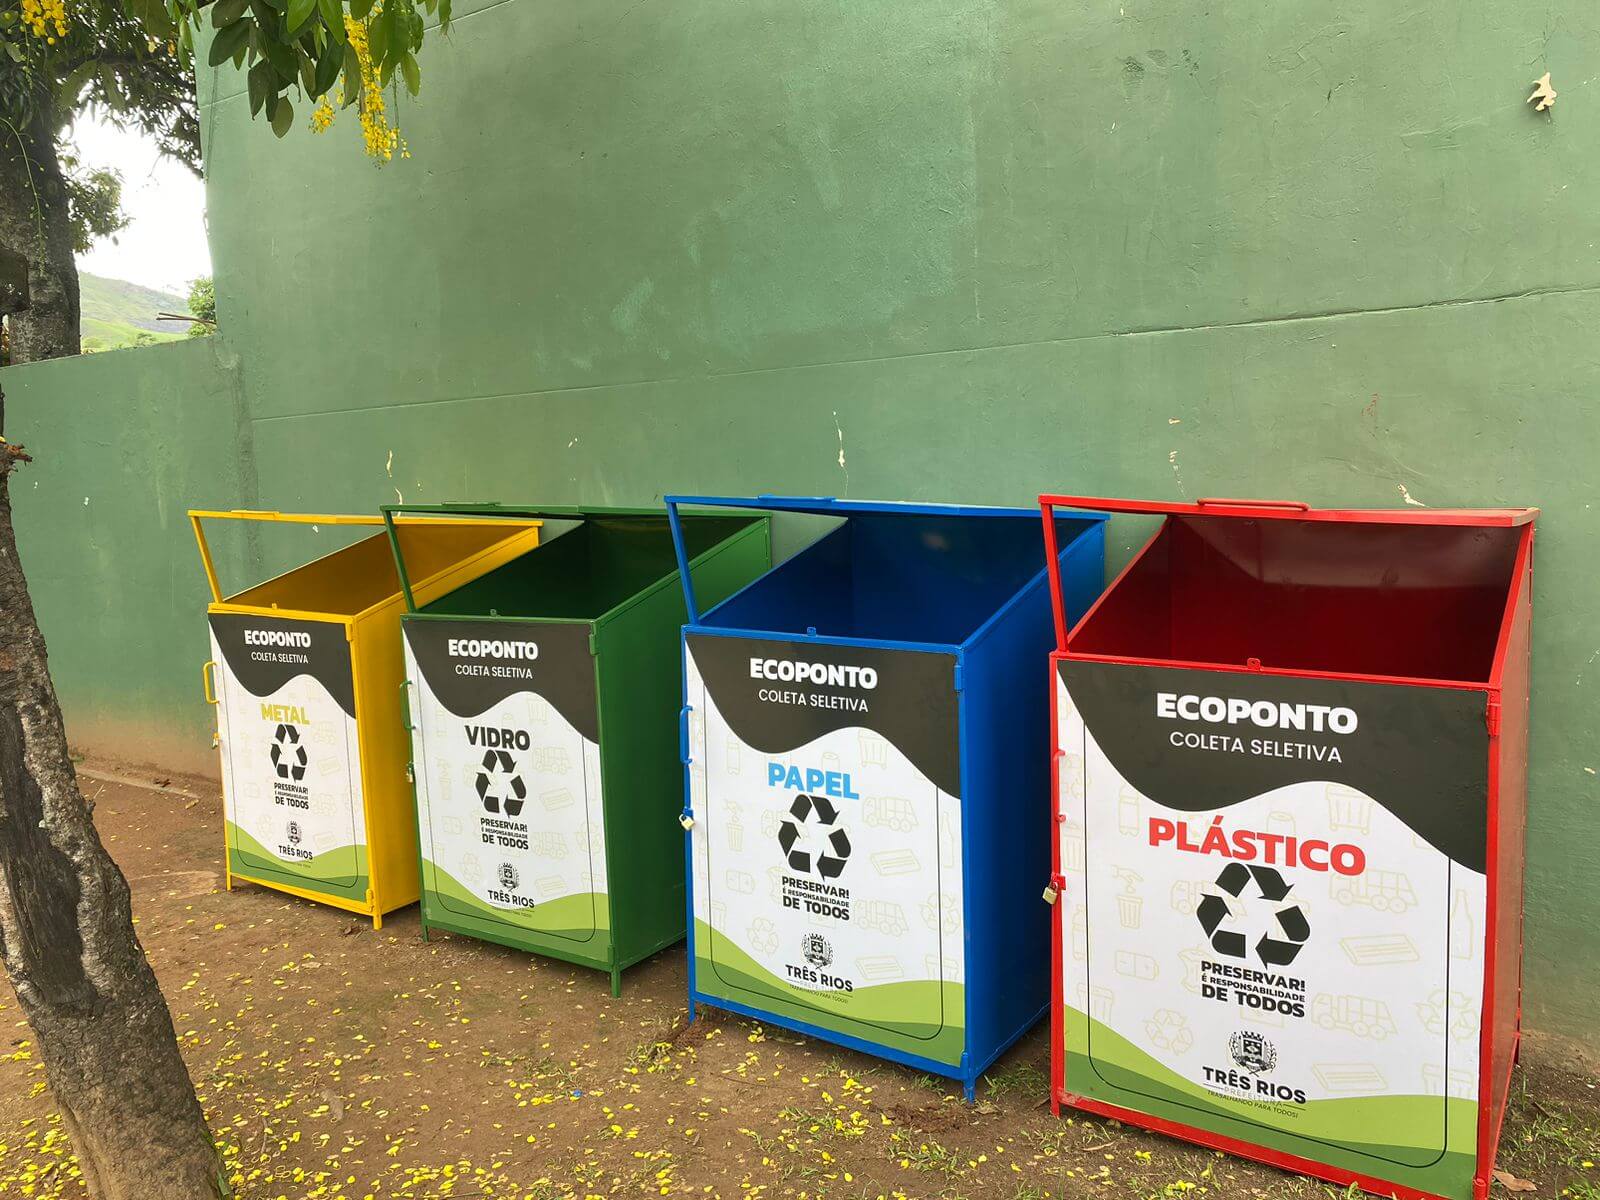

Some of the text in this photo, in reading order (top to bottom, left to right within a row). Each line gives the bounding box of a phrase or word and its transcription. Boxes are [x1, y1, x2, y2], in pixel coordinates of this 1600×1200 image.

[244, 630, 311, 648] ECOPONTO
[448, 639, 538, 660] ECOPONTO
[251, 652, 308, 664] COLETA SELETIVA
[455, 664, 532, 679] COLETA SELETIVA
[750, 658, 878, 689] ECOPONTO
[758, 689, 868, 712] COLETA SELETIVA
[262, 704, 310, 724] METAL
[1157, 692, 1358, 734] ECOPONTO
[464, 725, 530, 750] VIDRO
[1170, 732, 1342, 763] COLETA SELETIVA
[768, 762, 859, 800] PAPEL
[276, 796, 309, 810] DE TODOS
[480, 818, 528, 832] PRESERVAR!
[278, 844, 295, 856] TRÊS
[297, 850, 312, 860] RIOS
[482, 834, 528, 850] DE TODOS
[1149, 815, 1366, 876] PLÁSTICO
[488, 890, 510, 903] TRÊS
[512, 896, 534, 908] RIOS
[782, 876, 850, 899] PRESERVAR!
[788, 888, 850, 908] RESPONSABILIDADE
[783, 896, 850, 920] DE TODOS
[786, 964, 817, 983] TRÊS
[820, 973, 853, 992] RIOS
[1202, 961, 1305, 992] PRESERVAR!
[1202, 973, 1304, 1002] É RESPONSABILIDADE
[1202, 984, 1304, 1018] DE TODOS
[1202, 1066, 1306, 1104] TRÊS RIOS
[1254, 1104, 1272, 1112] PARA
